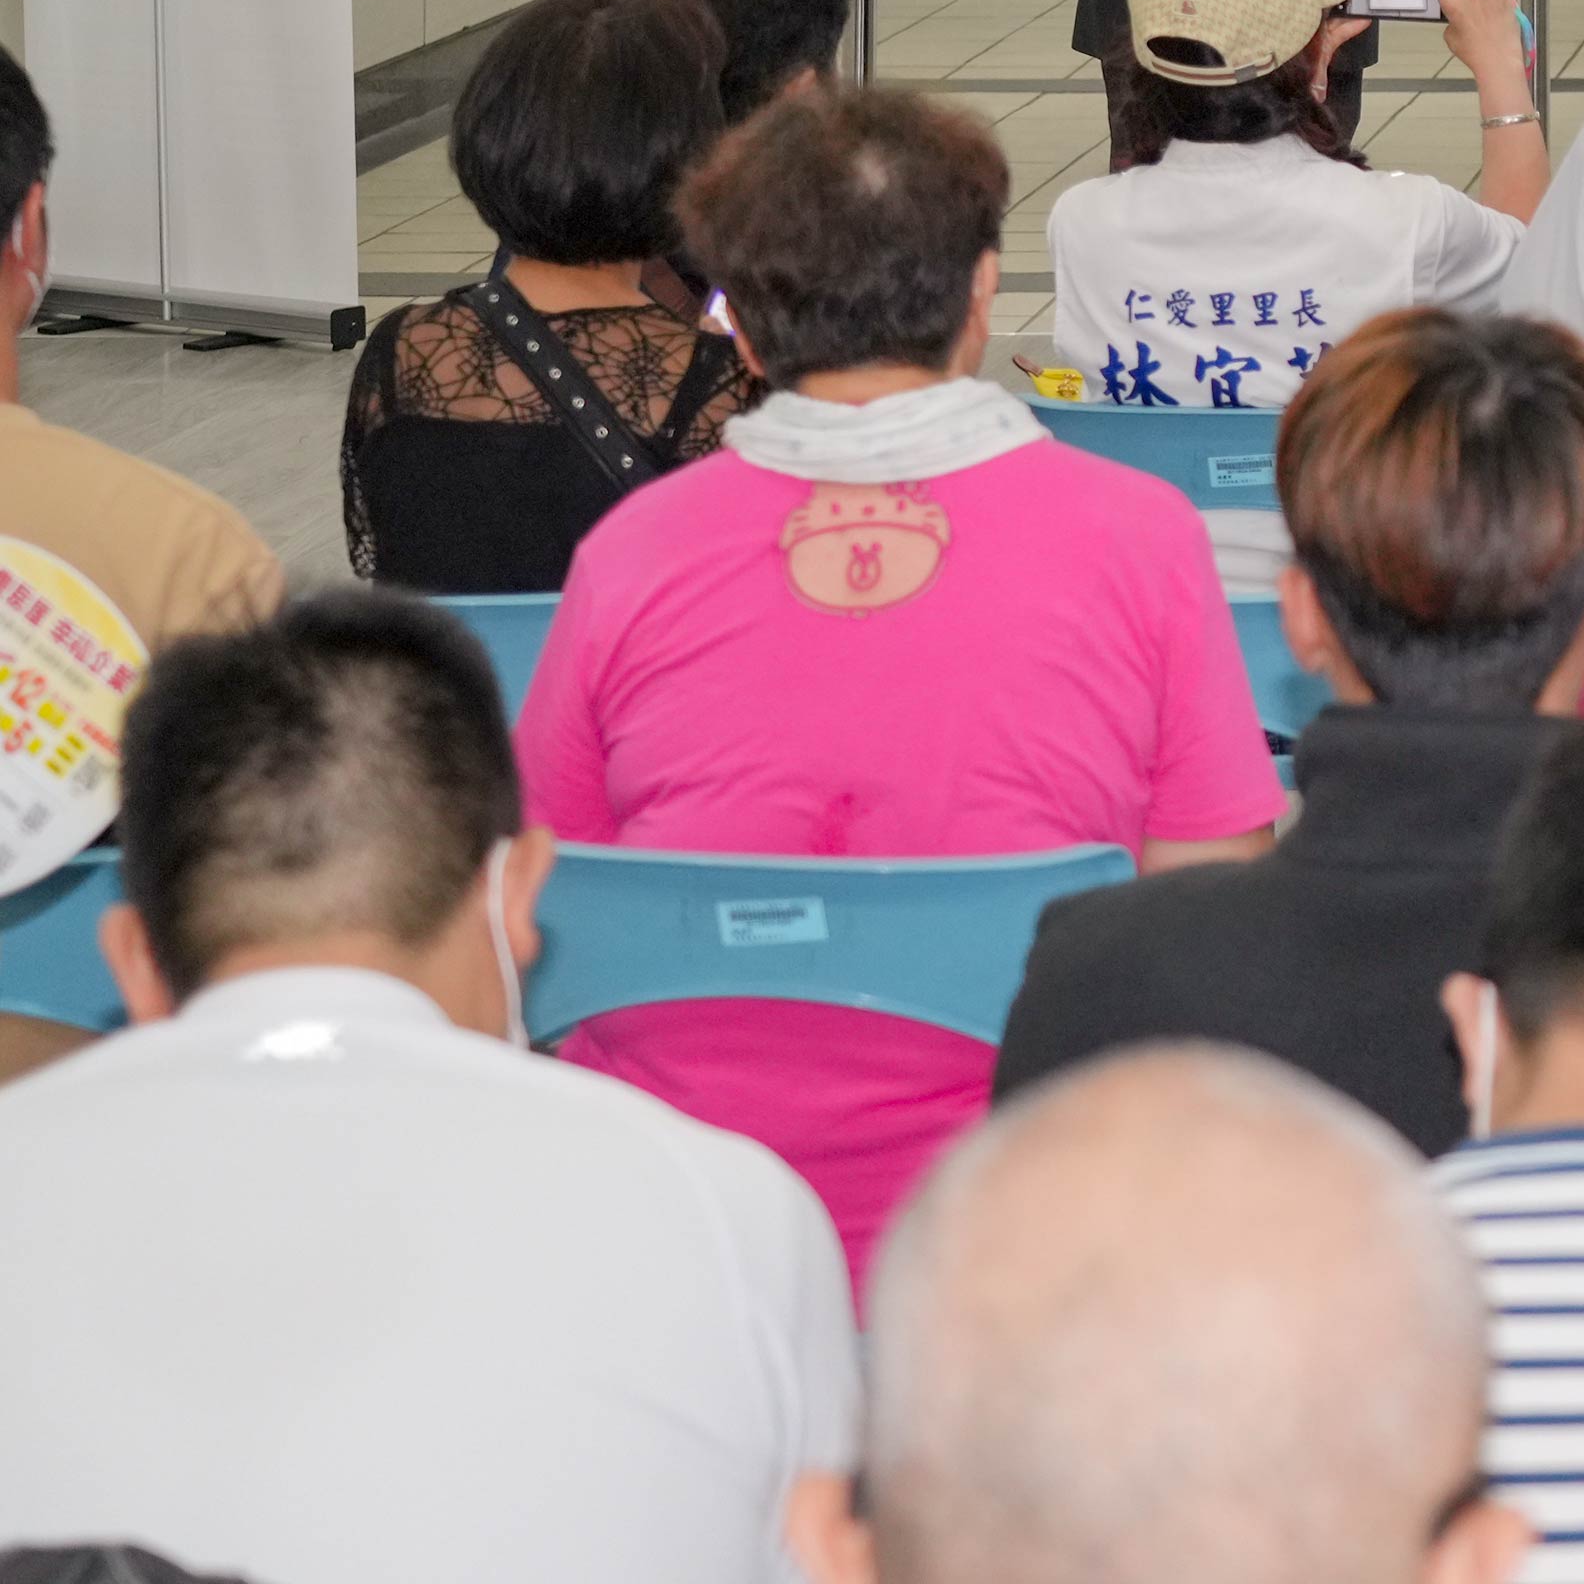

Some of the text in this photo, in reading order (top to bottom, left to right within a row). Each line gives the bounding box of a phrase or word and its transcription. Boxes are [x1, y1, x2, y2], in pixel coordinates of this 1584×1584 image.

[1125, 288, 1327, 329] 仁愛里里長
